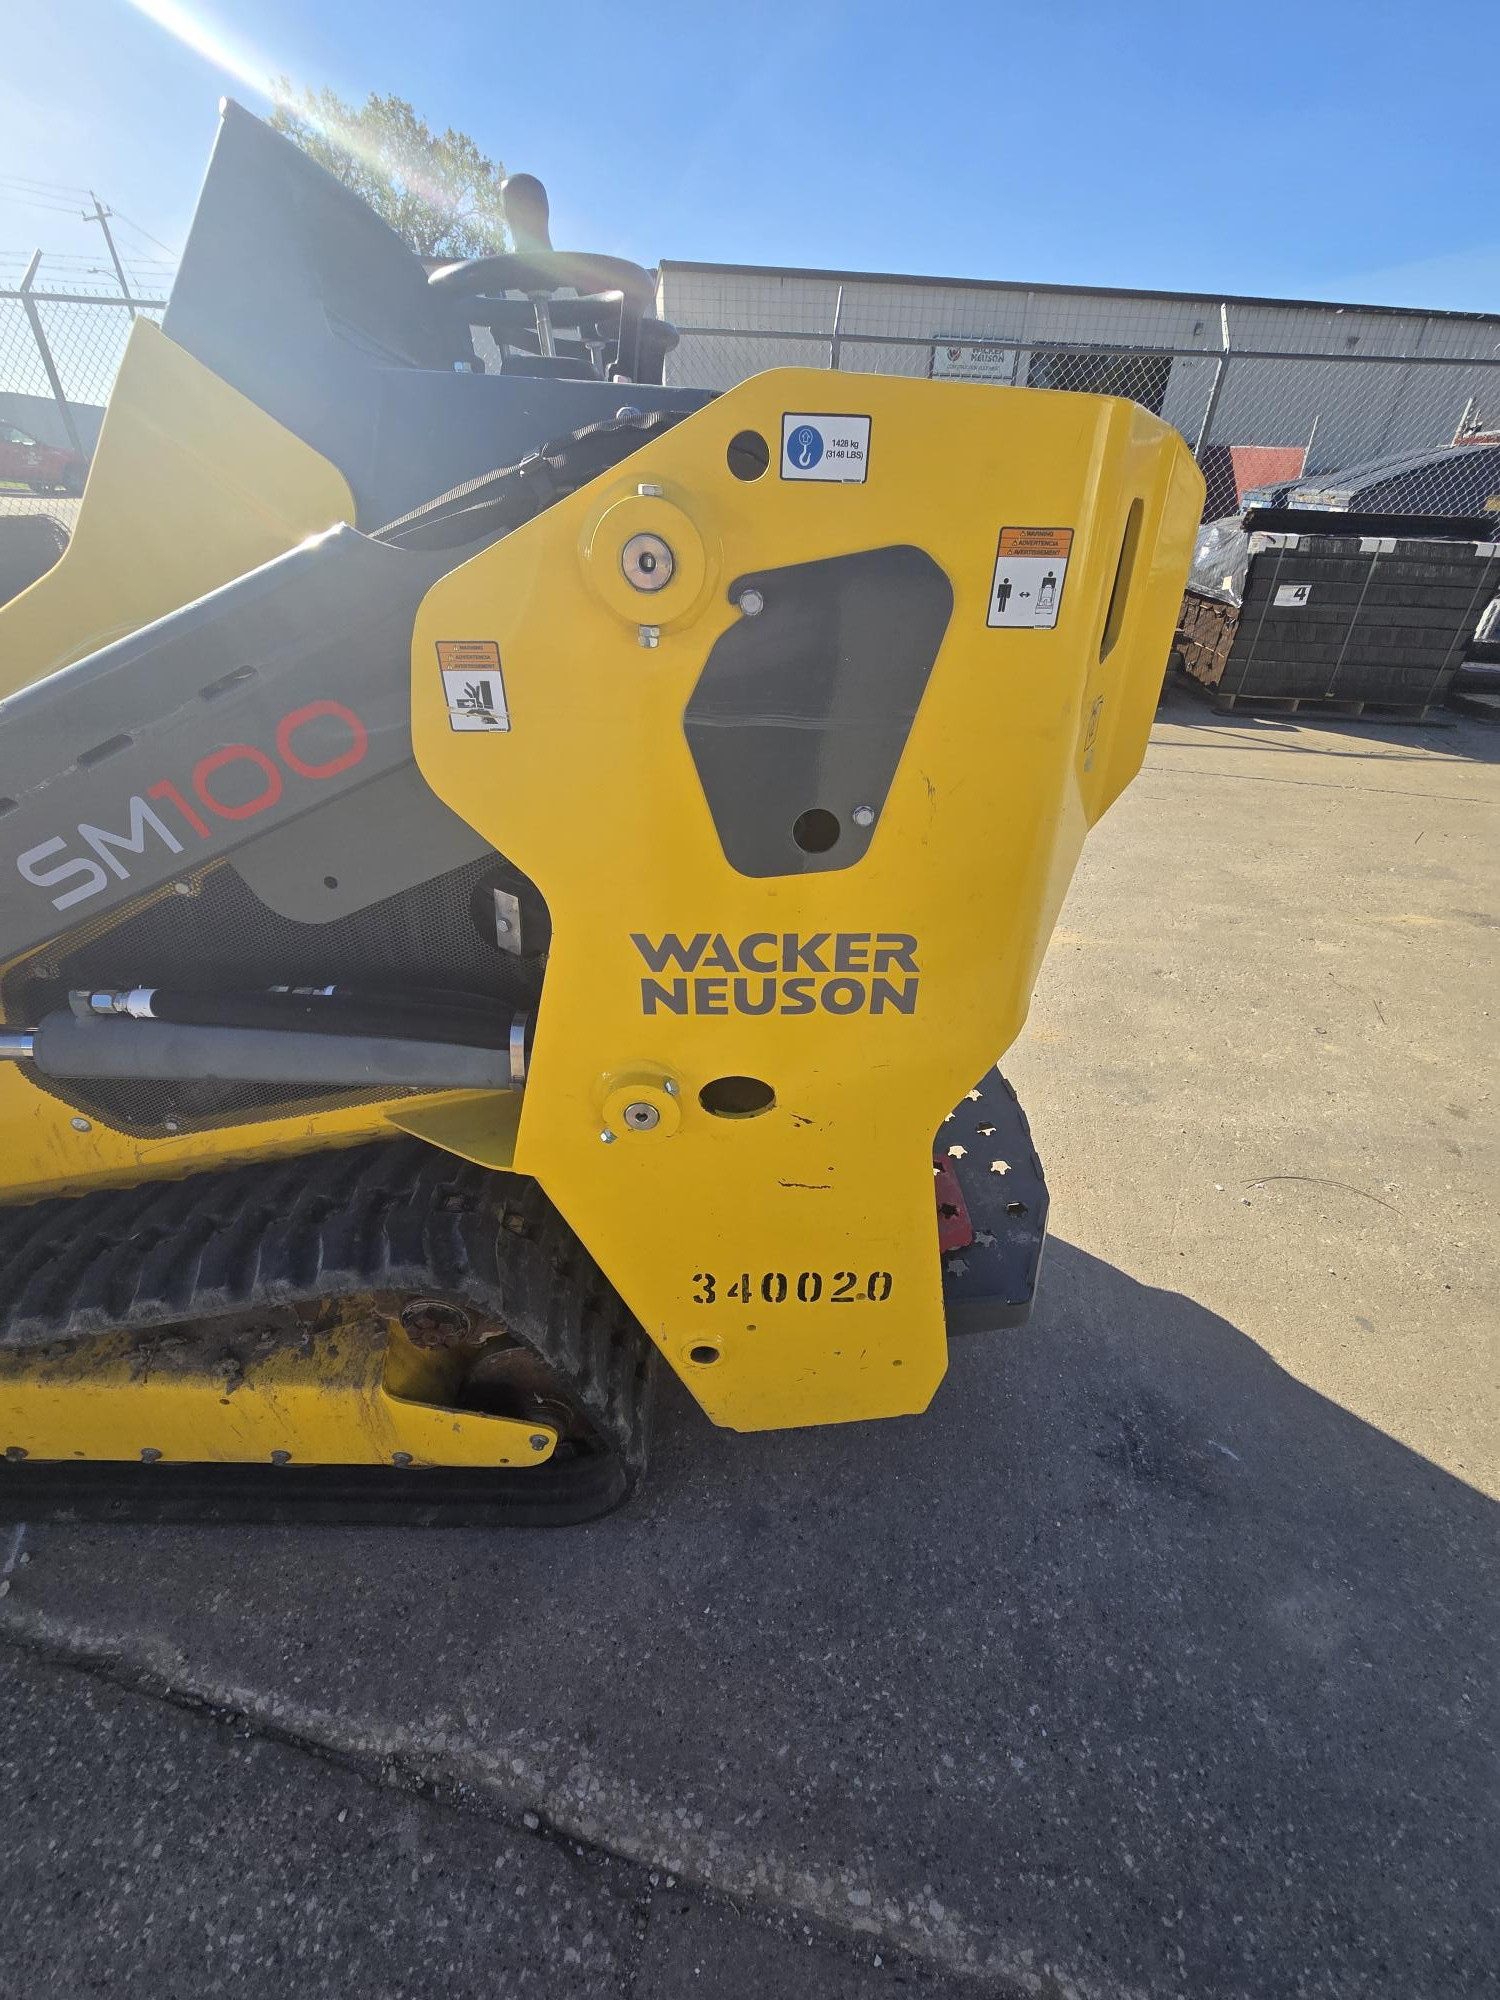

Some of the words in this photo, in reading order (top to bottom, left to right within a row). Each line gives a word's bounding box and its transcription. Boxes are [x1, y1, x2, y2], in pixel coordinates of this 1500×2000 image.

[971, 353, 1004, 363] NEUSON
[826, 450, 845, 460] (3148
[846, 450, 864, 461] LBS)
[850, 439, 859, 450] kg
[1293, 586, 1307, 601] 4
[16, 699, 368, 911] SM100
[629, 932, 921, 973] WACKER
[640, 977, 919, 1016] NEUSON
[692, 1271, 893, 1304] 340020
